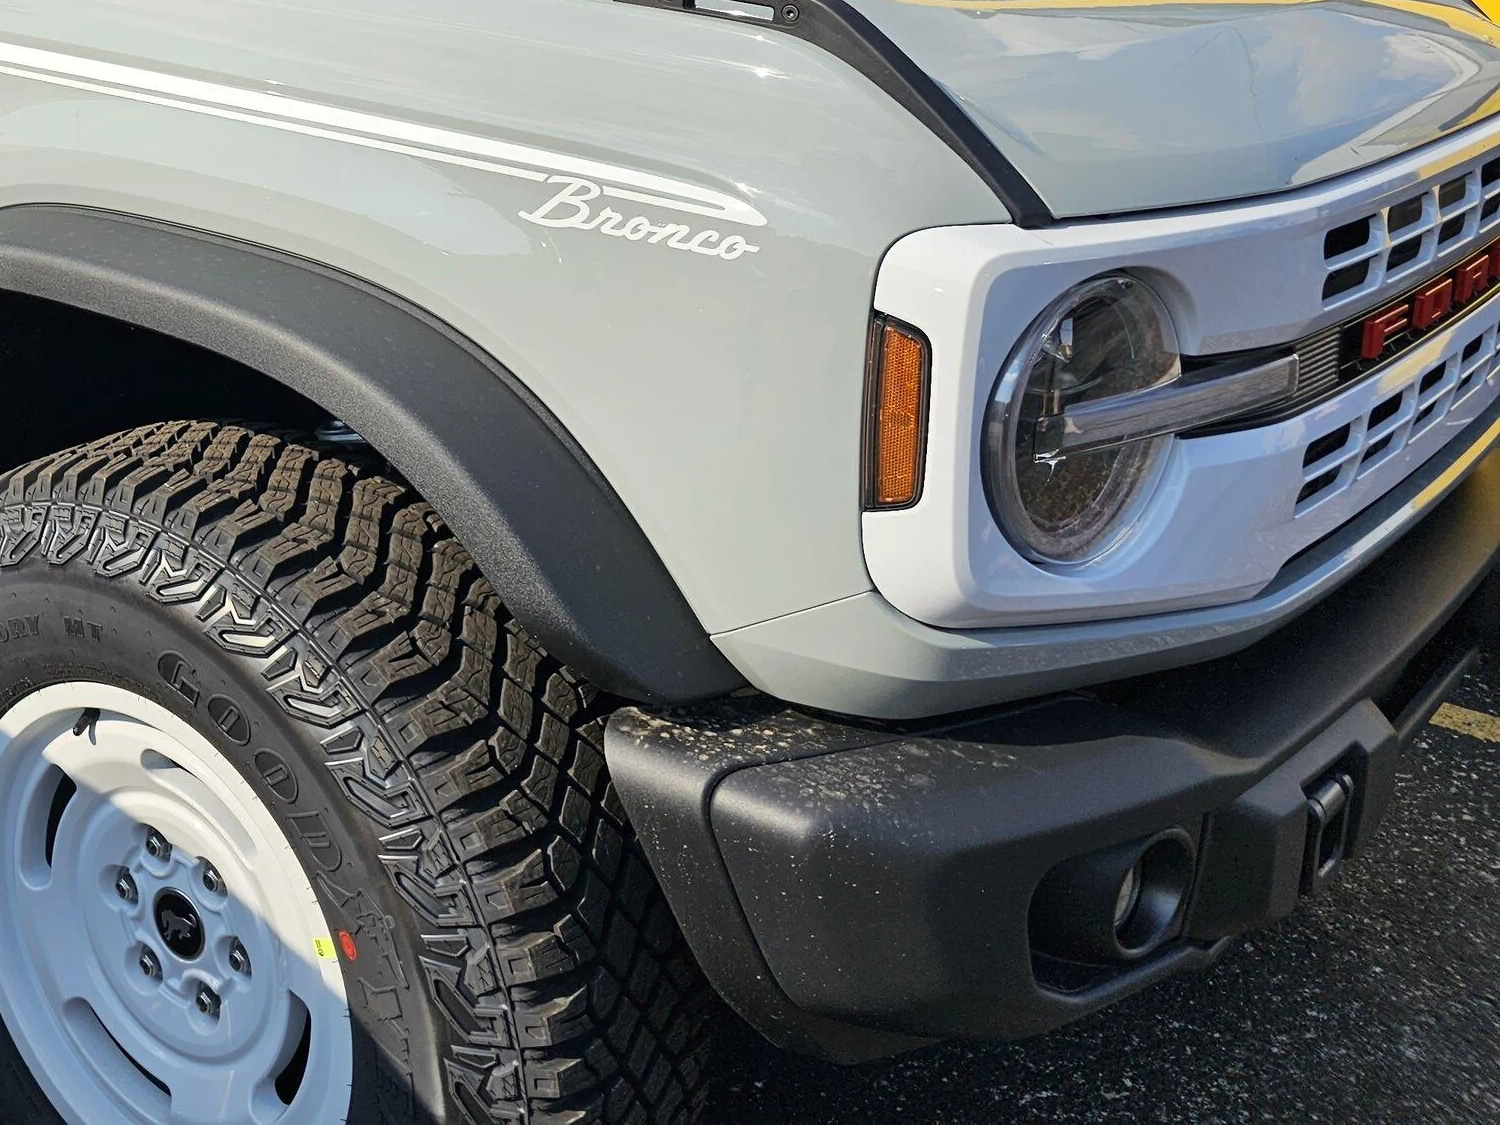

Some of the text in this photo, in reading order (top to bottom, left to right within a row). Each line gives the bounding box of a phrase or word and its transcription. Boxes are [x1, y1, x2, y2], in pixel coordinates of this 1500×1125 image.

[517, 175, 760, 261] Bronco
[1360, 237, 1500, 361] FOR
[157, 649, 342, 872] GOOD
